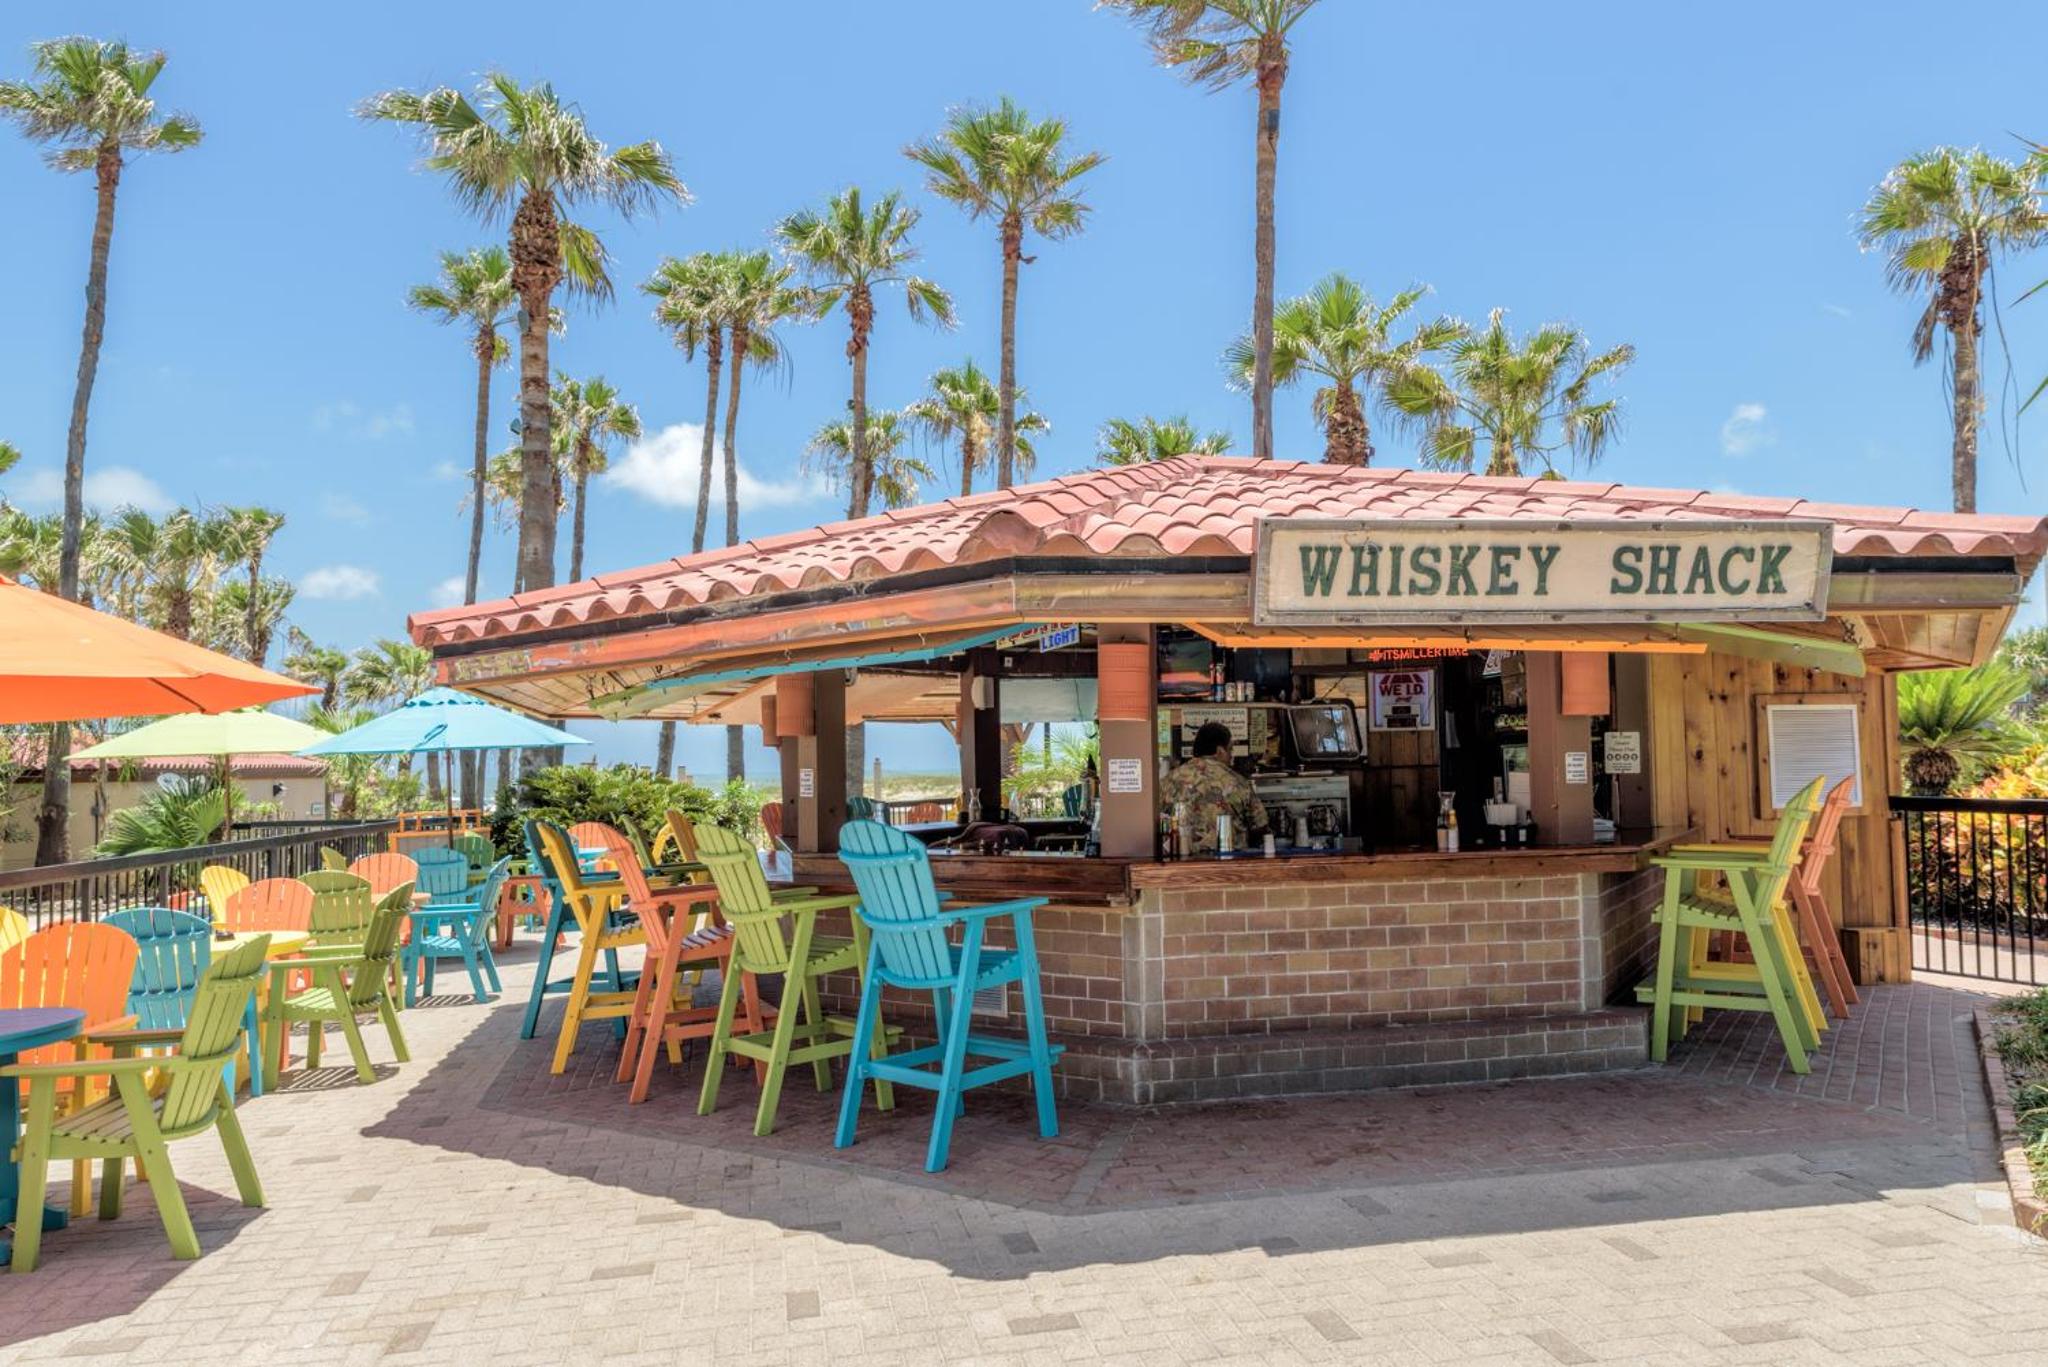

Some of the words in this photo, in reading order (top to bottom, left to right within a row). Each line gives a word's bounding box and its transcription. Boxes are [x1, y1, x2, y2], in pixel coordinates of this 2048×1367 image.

[1298, 544, 1561, 597] WHISKEY
[1610, 544, 1792, 596] SHACK
[1041, 627, 1077, 650] LIGHT
[1379, 684, 1401, 696] WE
